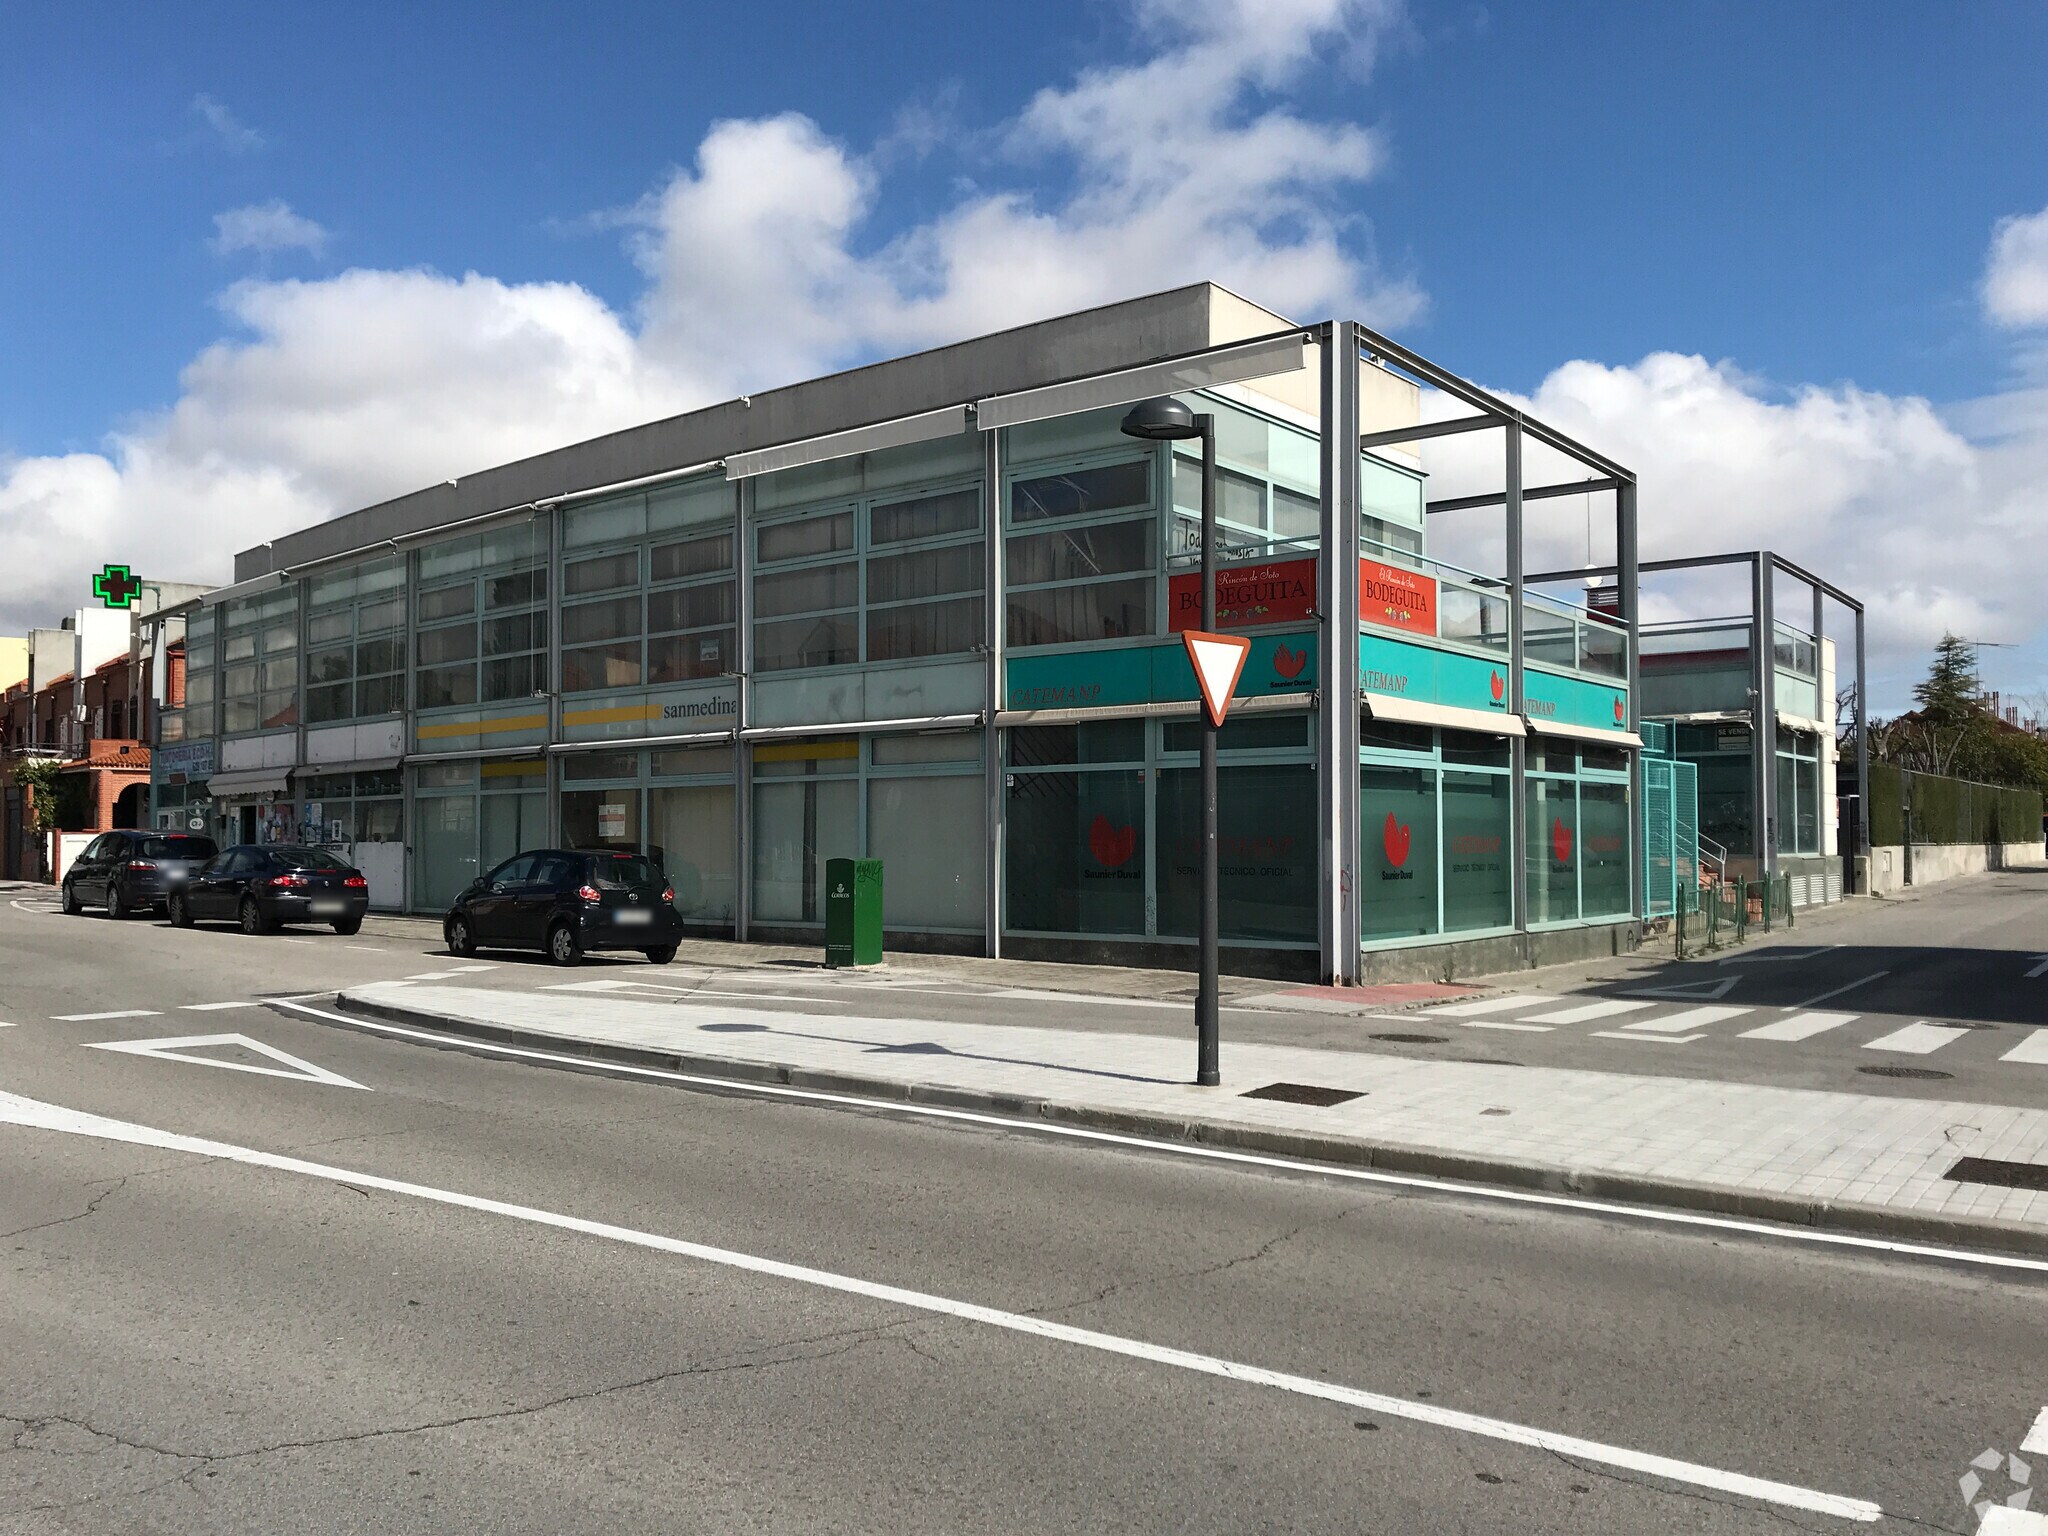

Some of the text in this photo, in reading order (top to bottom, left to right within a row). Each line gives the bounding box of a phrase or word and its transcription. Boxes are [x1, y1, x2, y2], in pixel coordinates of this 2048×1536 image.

[1249, 570, 1258, 582] de
[1260, 566, 1280, 580] Soto
[1365, 579, 1428, 613] BODEGUITA
[1360, 669, 1408, 693] ATEMANP
[1011, 684, 1102, 706] CATEMANP
[664, 696, 737, 719] sanmedina
[1523, 698, 1556, 716] ATEMANP
[1084, 869, 1141, 879] Saunier Duval
[1176, 866, 1200, 876] SERVI
[1260, 867, 1294, 877] OFICIAL
